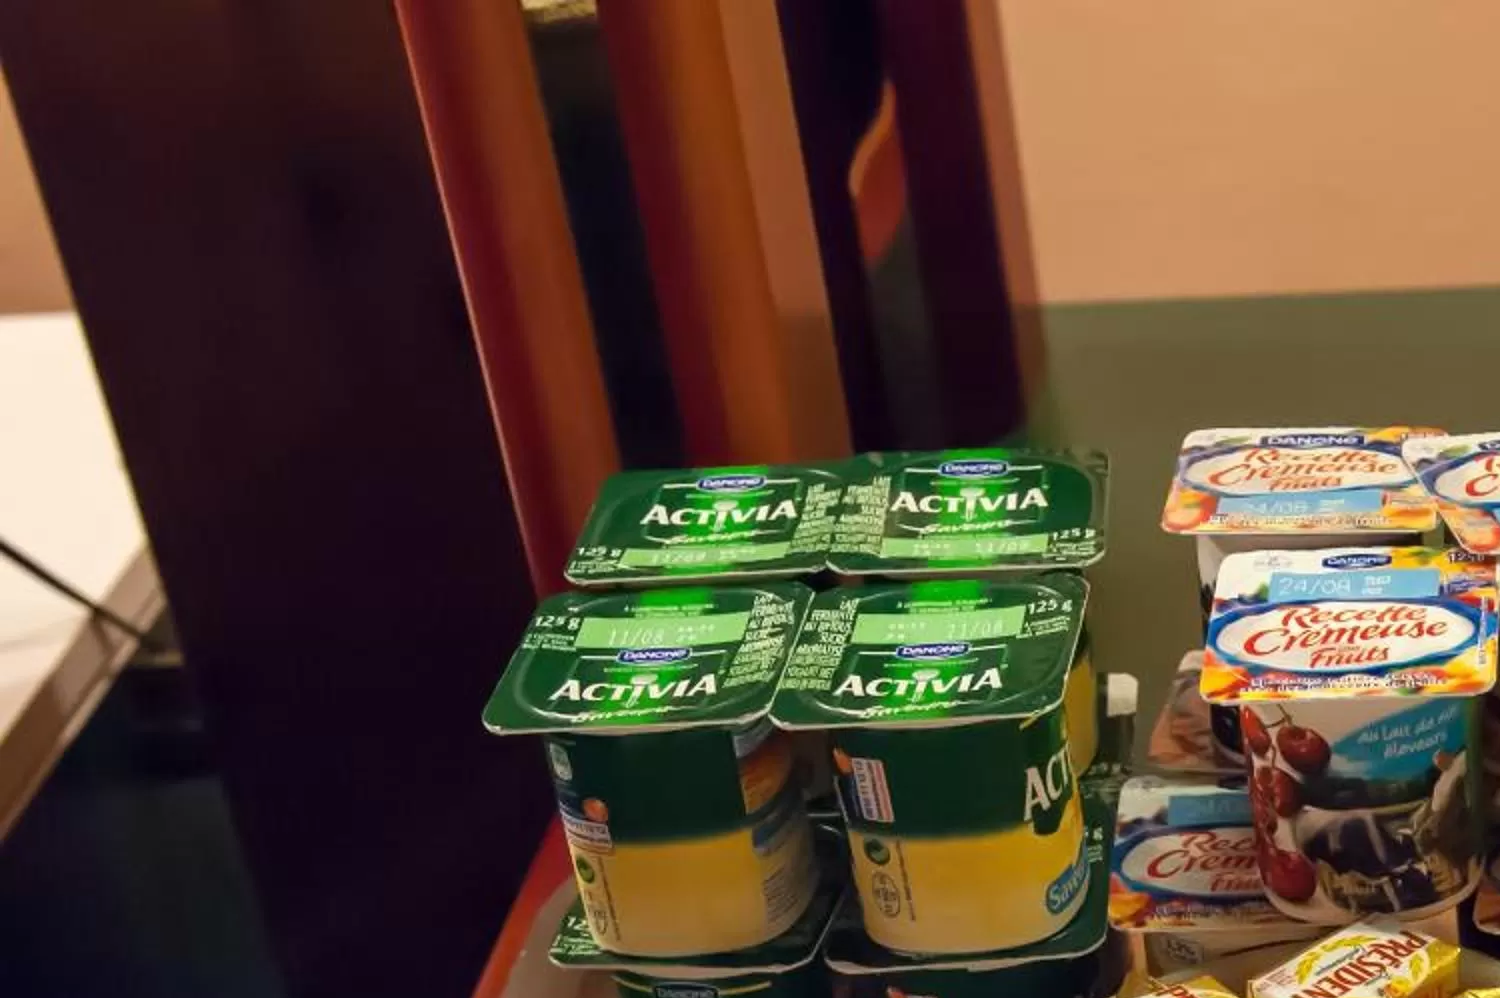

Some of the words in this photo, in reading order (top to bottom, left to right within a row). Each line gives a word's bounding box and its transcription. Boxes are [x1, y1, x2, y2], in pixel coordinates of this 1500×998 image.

[1245, 448, 1378, 463] Recette
[640, 499, 798, 530] ACTIVIA
[890, 488, 1048, 519] ACTIVIA
[1281, 605, 1428, 629] Recette
[1309, 646, 1390, 669] Fruits
[549, 673, 718, 705] ACTIVIA
[833, 667, 1003, 702] ACTIVIA
